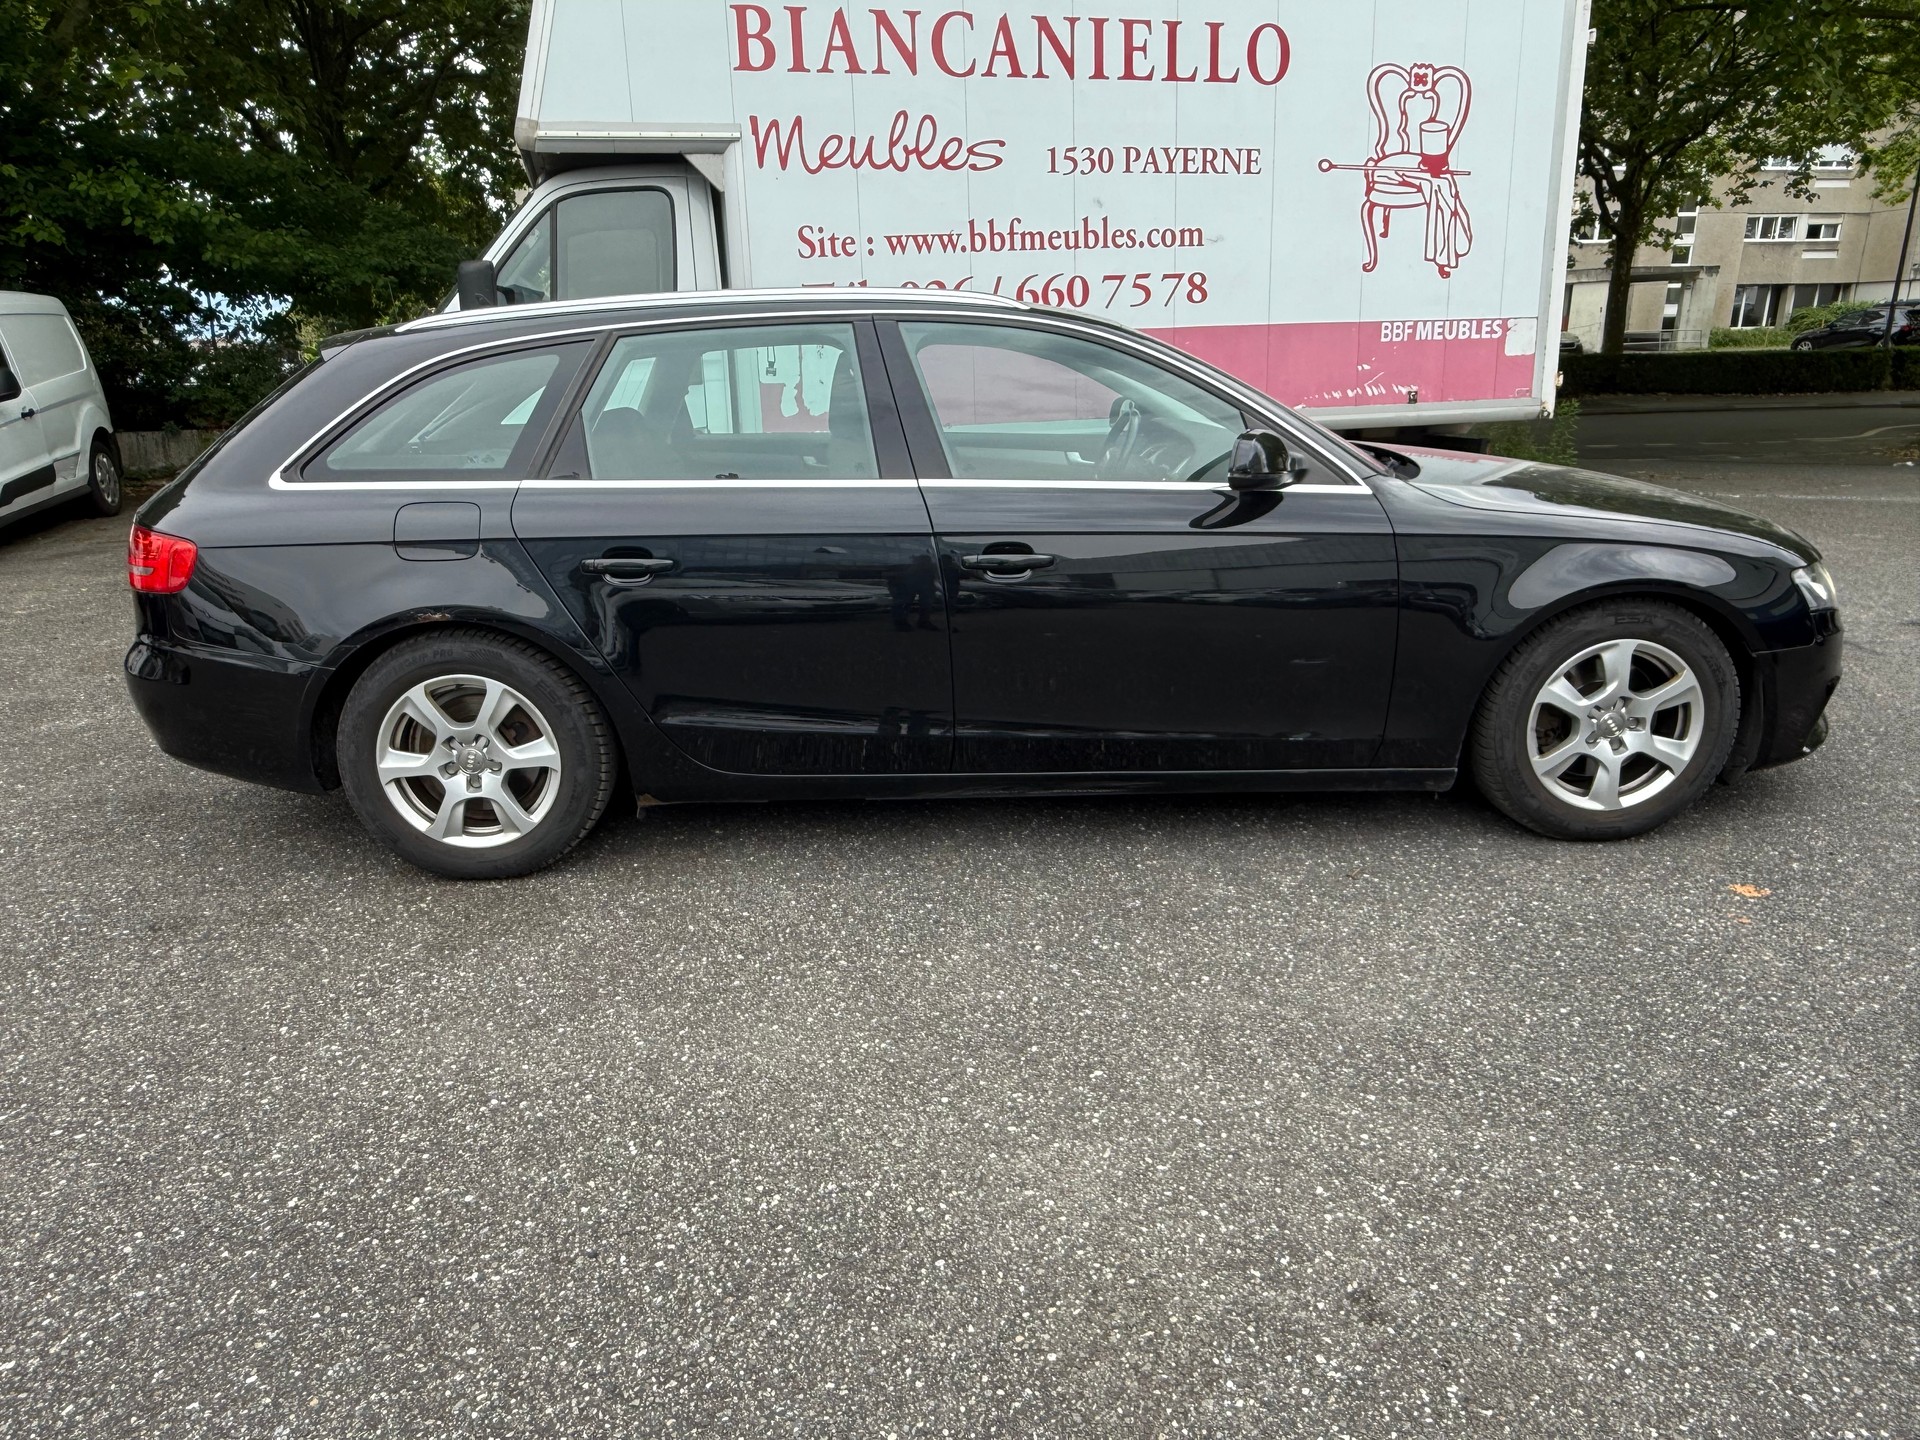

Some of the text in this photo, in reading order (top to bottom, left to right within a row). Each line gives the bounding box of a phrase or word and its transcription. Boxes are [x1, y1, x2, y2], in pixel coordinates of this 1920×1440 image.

[729, 3, 1291, 86] BIANCANIELLO
[749, 109, 1006, 175] Meubles
[1046, 147, 1263, 176] 1530 PAYERNE
[797, 223, 857, 259] Site
[883, 216, 1205, 256] www.bbfmeubles.com
[1015, 273, 1091, 308] 660
[1380, 319, 1503, 342] BBF MEUBLES
